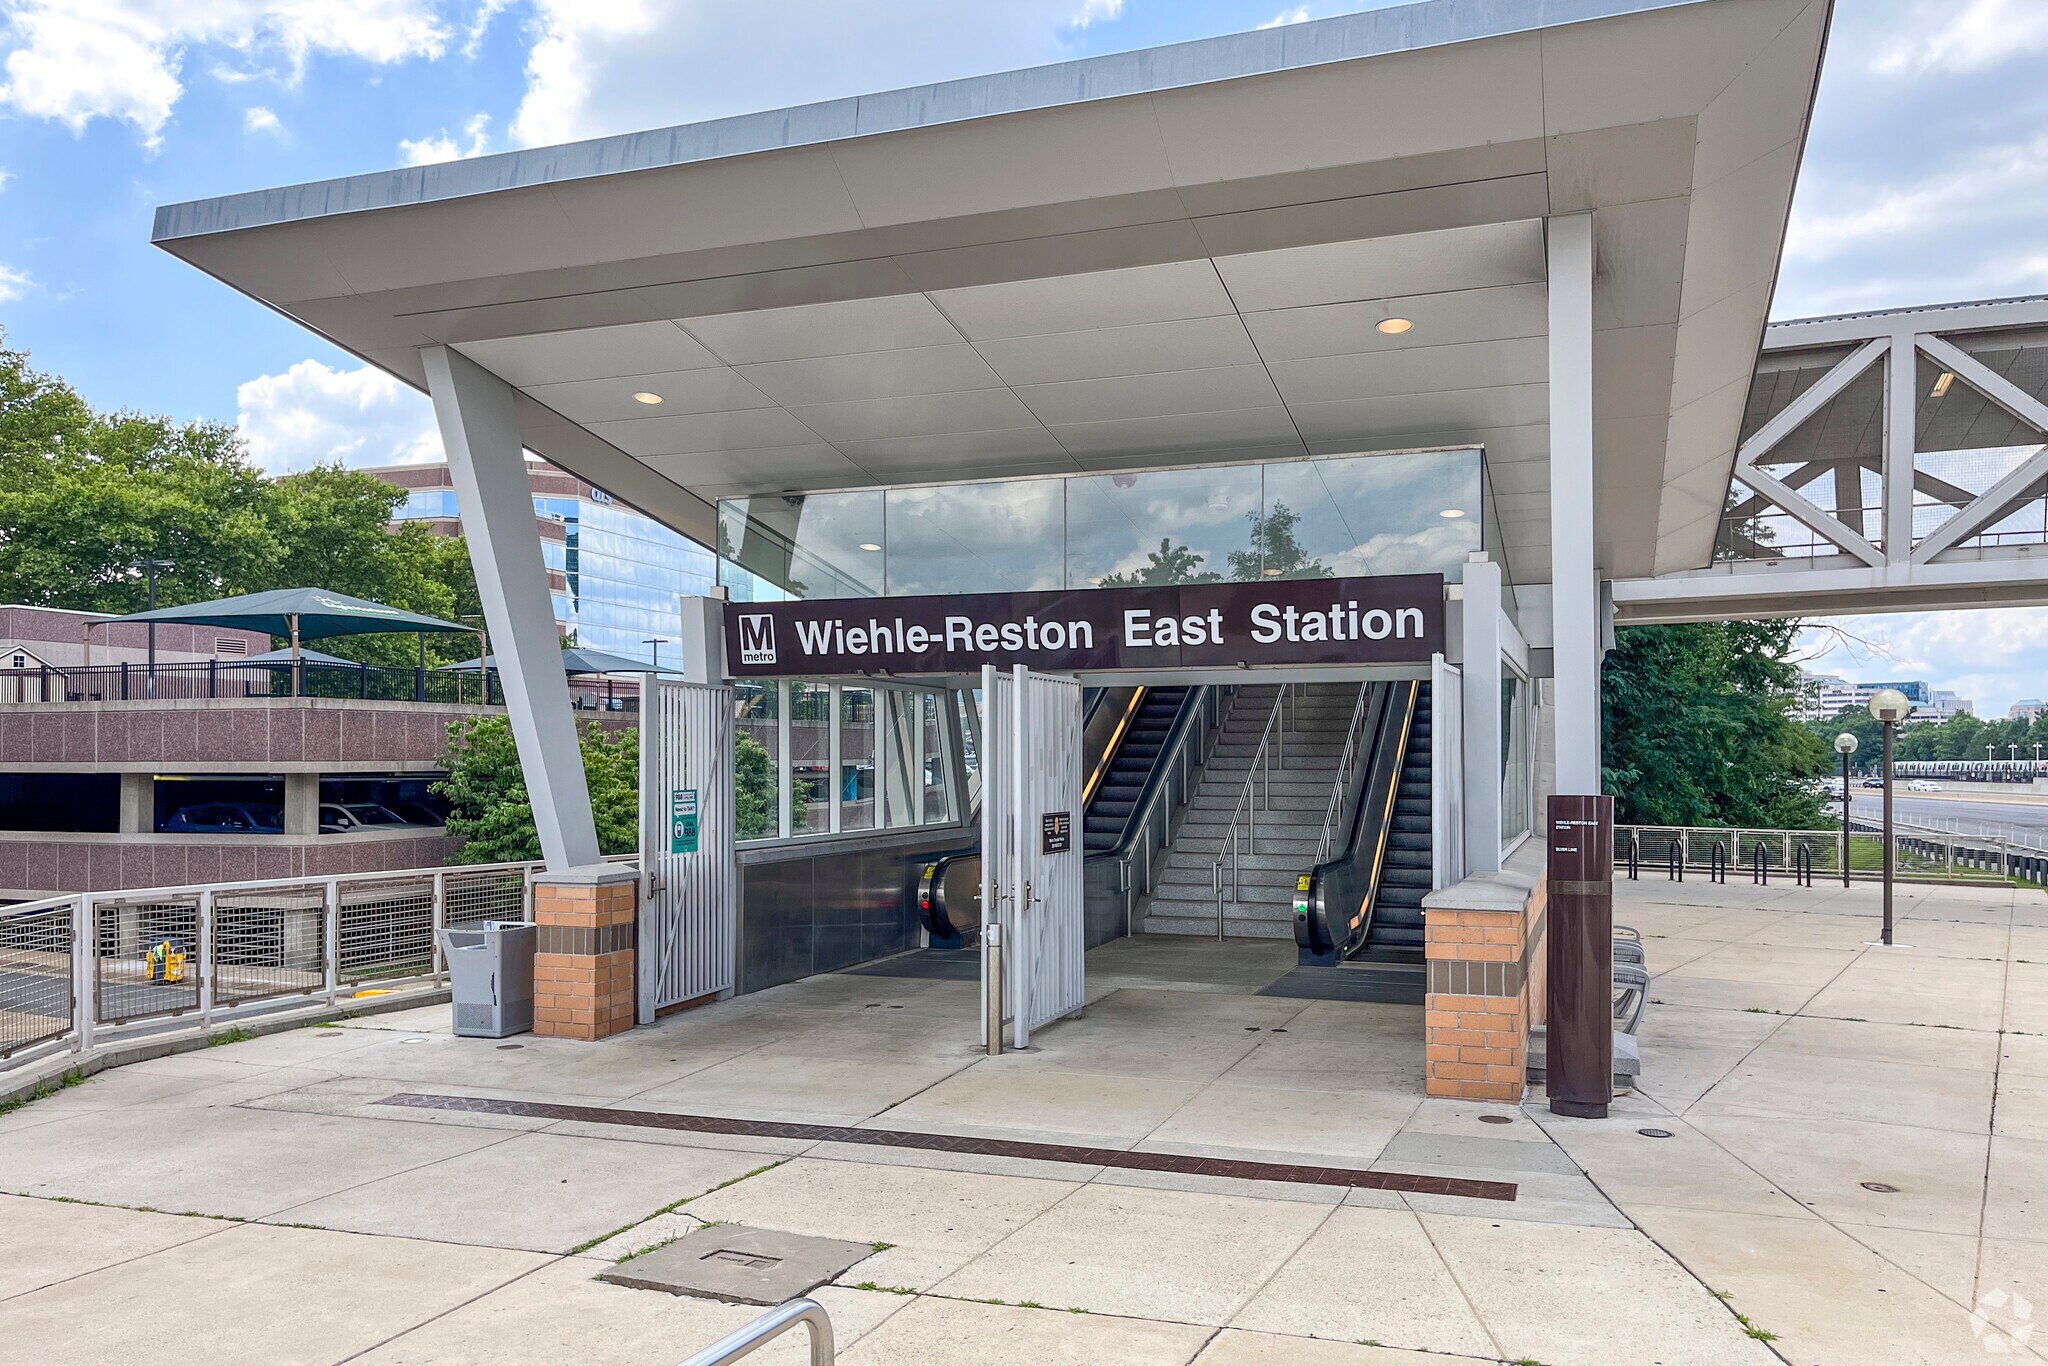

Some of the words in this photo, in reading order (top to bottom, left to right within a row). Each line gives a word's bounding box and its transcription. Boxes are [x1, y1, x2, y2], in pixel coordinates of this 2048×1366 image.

[741, 616, 773, 650] M
[794, 615, 1094, 656] Wiehle-Reston
[1124, 608, 1224, 648] East
[1250, 600, 1425, 644] Station
[744, 651, 774, 662] metro
[684, 827, 696, 838] 988
